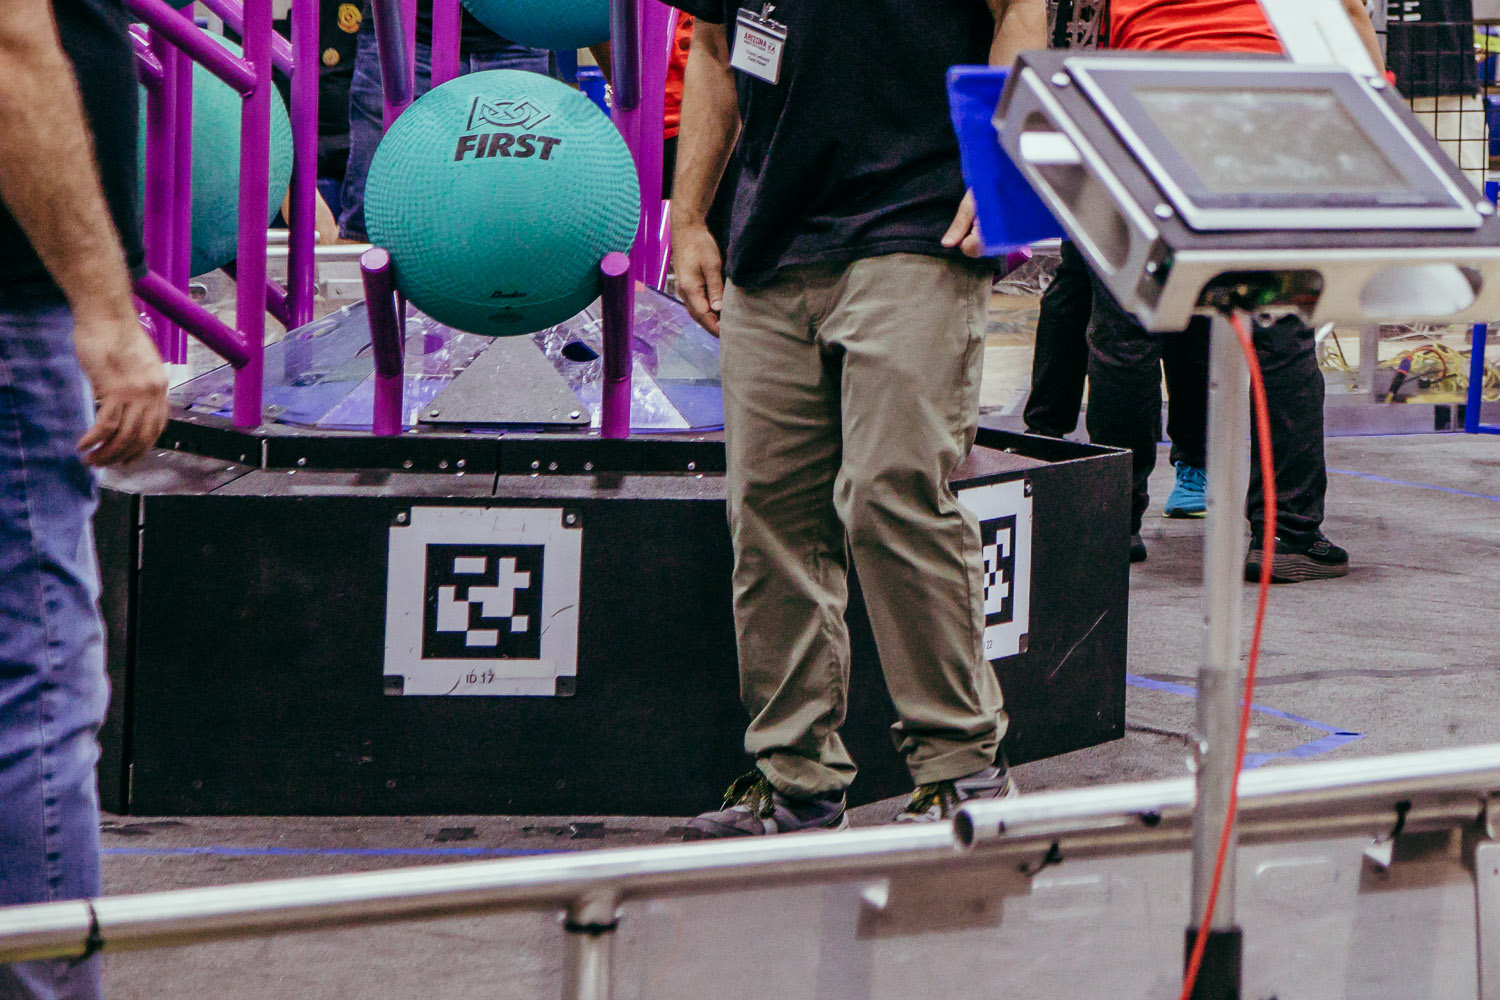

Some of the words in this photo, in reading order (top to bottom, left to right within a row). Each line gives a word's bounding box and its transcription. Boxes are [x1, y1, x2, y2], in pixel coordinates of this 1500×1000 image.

[454, 133, 562, 161] FIRST
[466, 673, 477, 684] ID
[481, 671, 495, 684] 17
